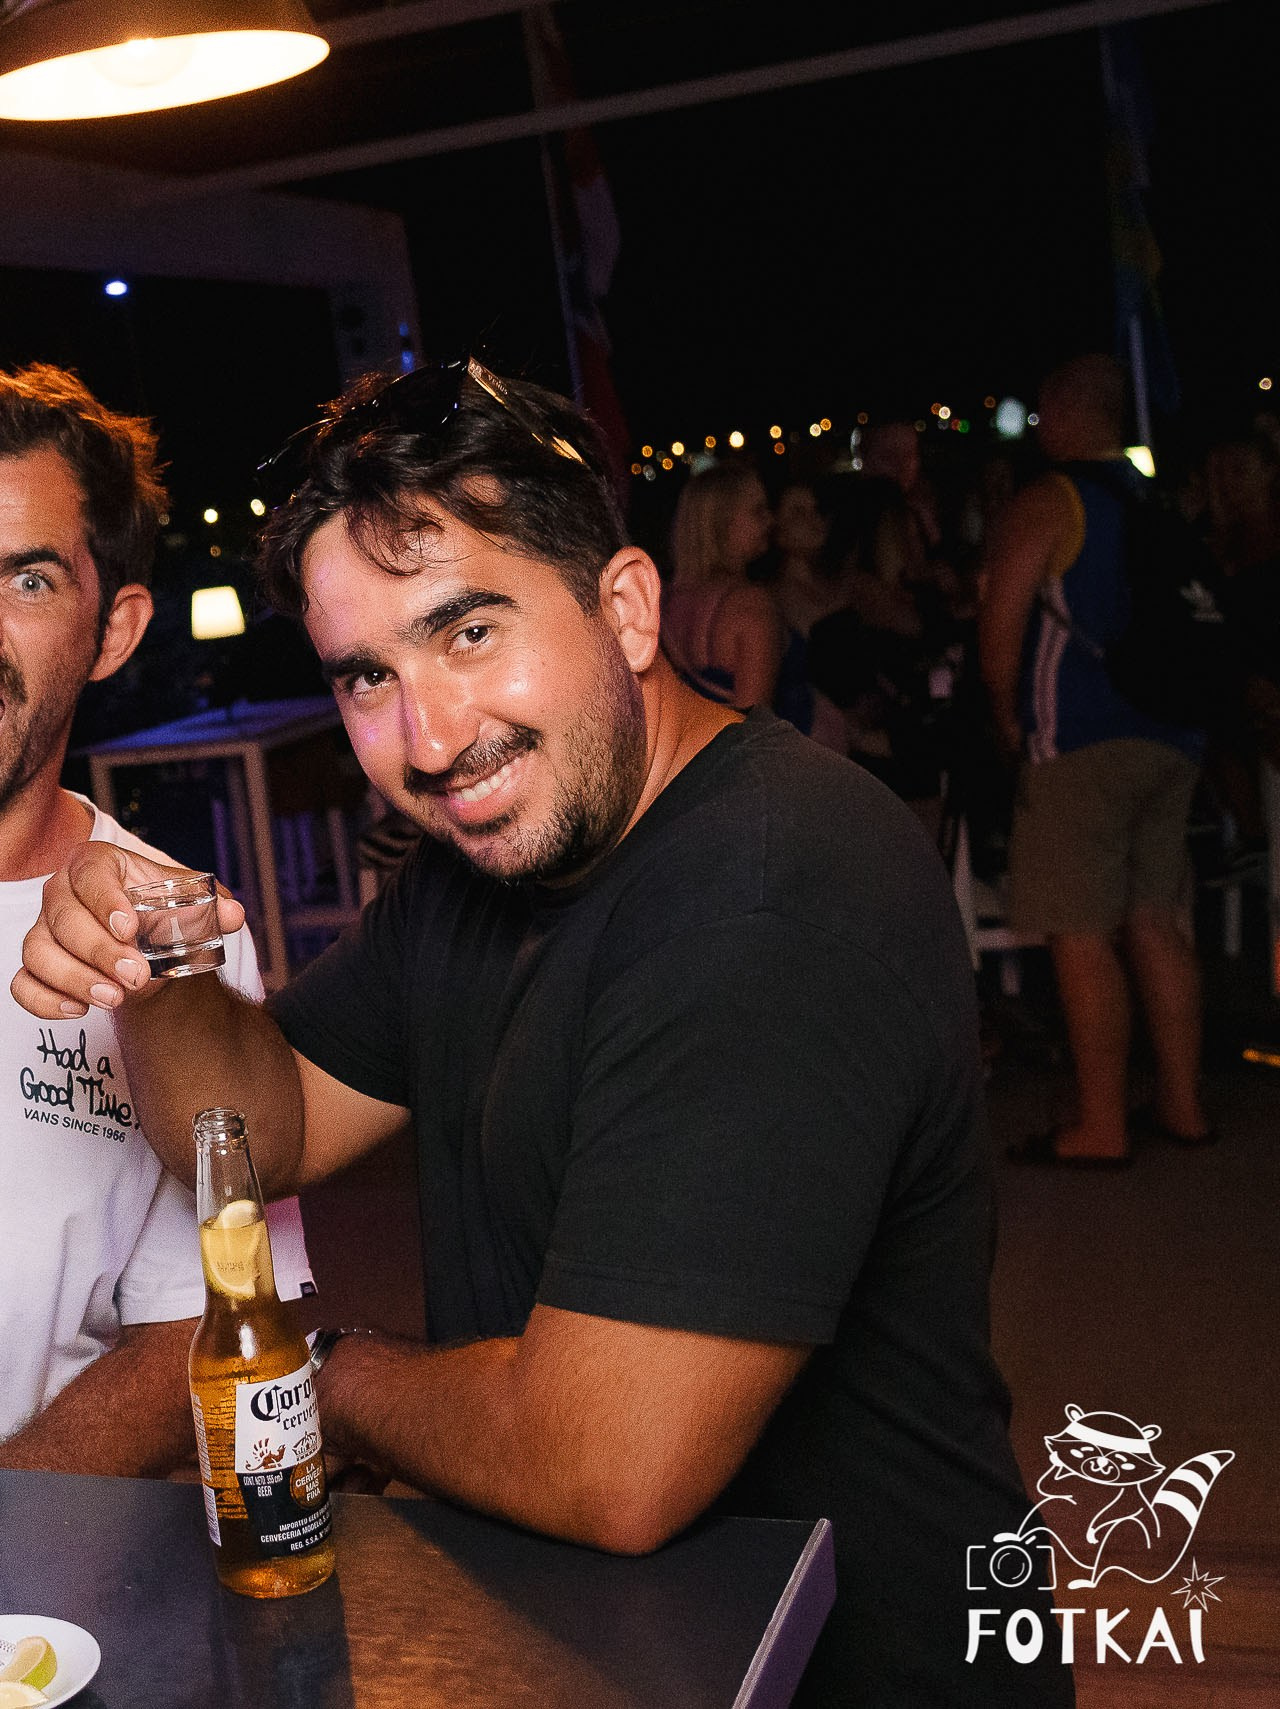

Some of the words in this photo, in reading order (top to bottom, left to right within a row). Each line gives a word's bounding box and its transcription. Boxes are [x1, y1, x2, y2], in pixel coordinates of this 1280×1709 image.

[37, 1028, 90, 1072] Had
[97, 1056, 114, 1079] a
[20, 1066, 75, 1112] Good
[24, 1107, 60, 1126] VANS
[61, 1116, 101, 1136] SINCE
[102, 1126, 126, 1143] 1966
[257, 1485, 273, 1497] BEER
